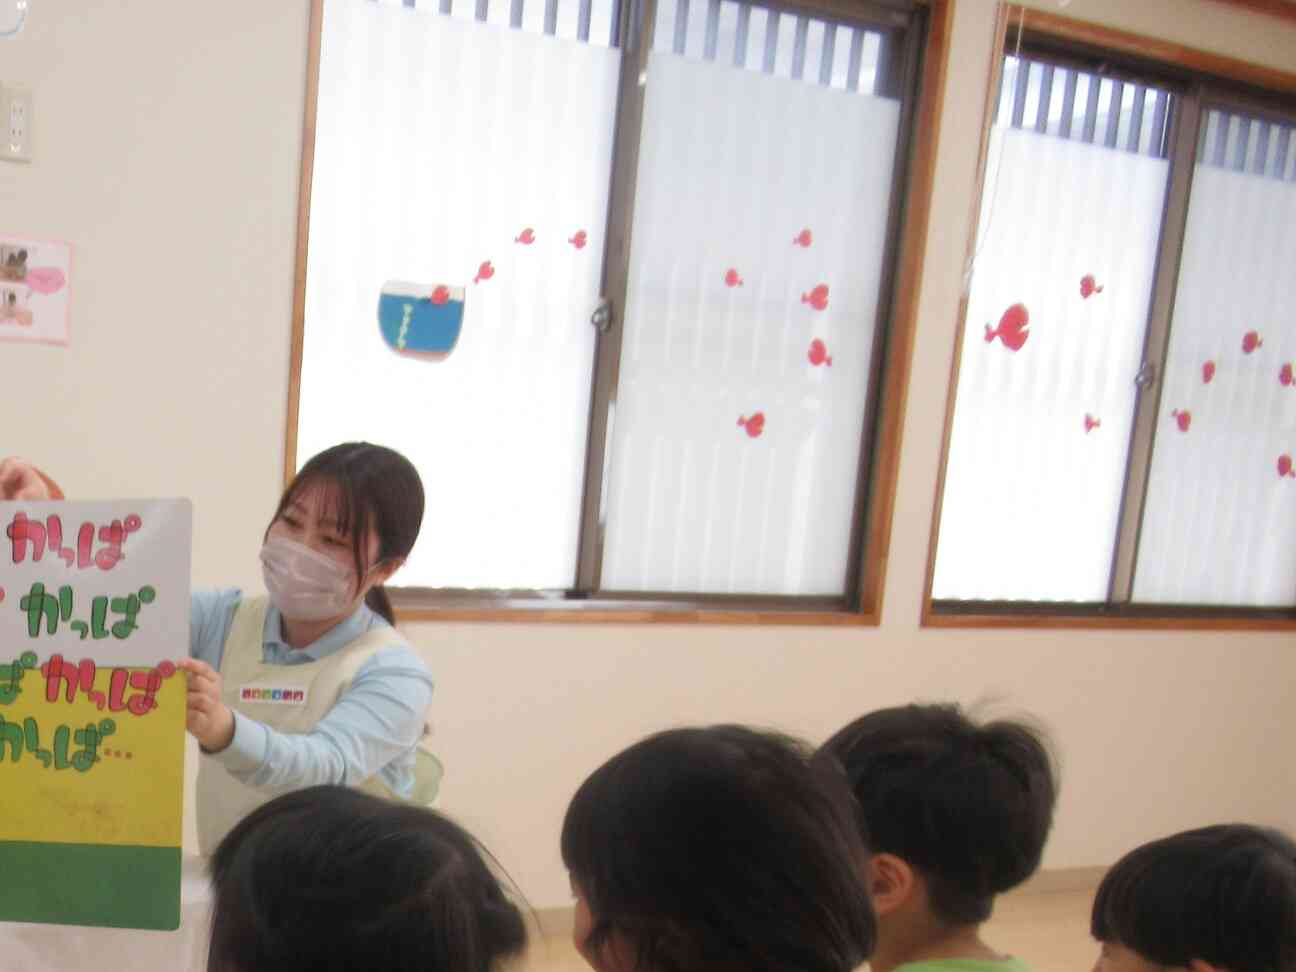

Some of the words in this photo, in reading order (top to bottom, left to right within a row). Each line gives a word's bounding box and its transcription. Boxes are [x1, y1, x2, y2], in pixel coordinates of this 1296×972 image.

[6, 511, 143, 571] かっぱ
[19, 581, 157, 640] かっぱ
[40, 653, 177, 716] かっぱ
